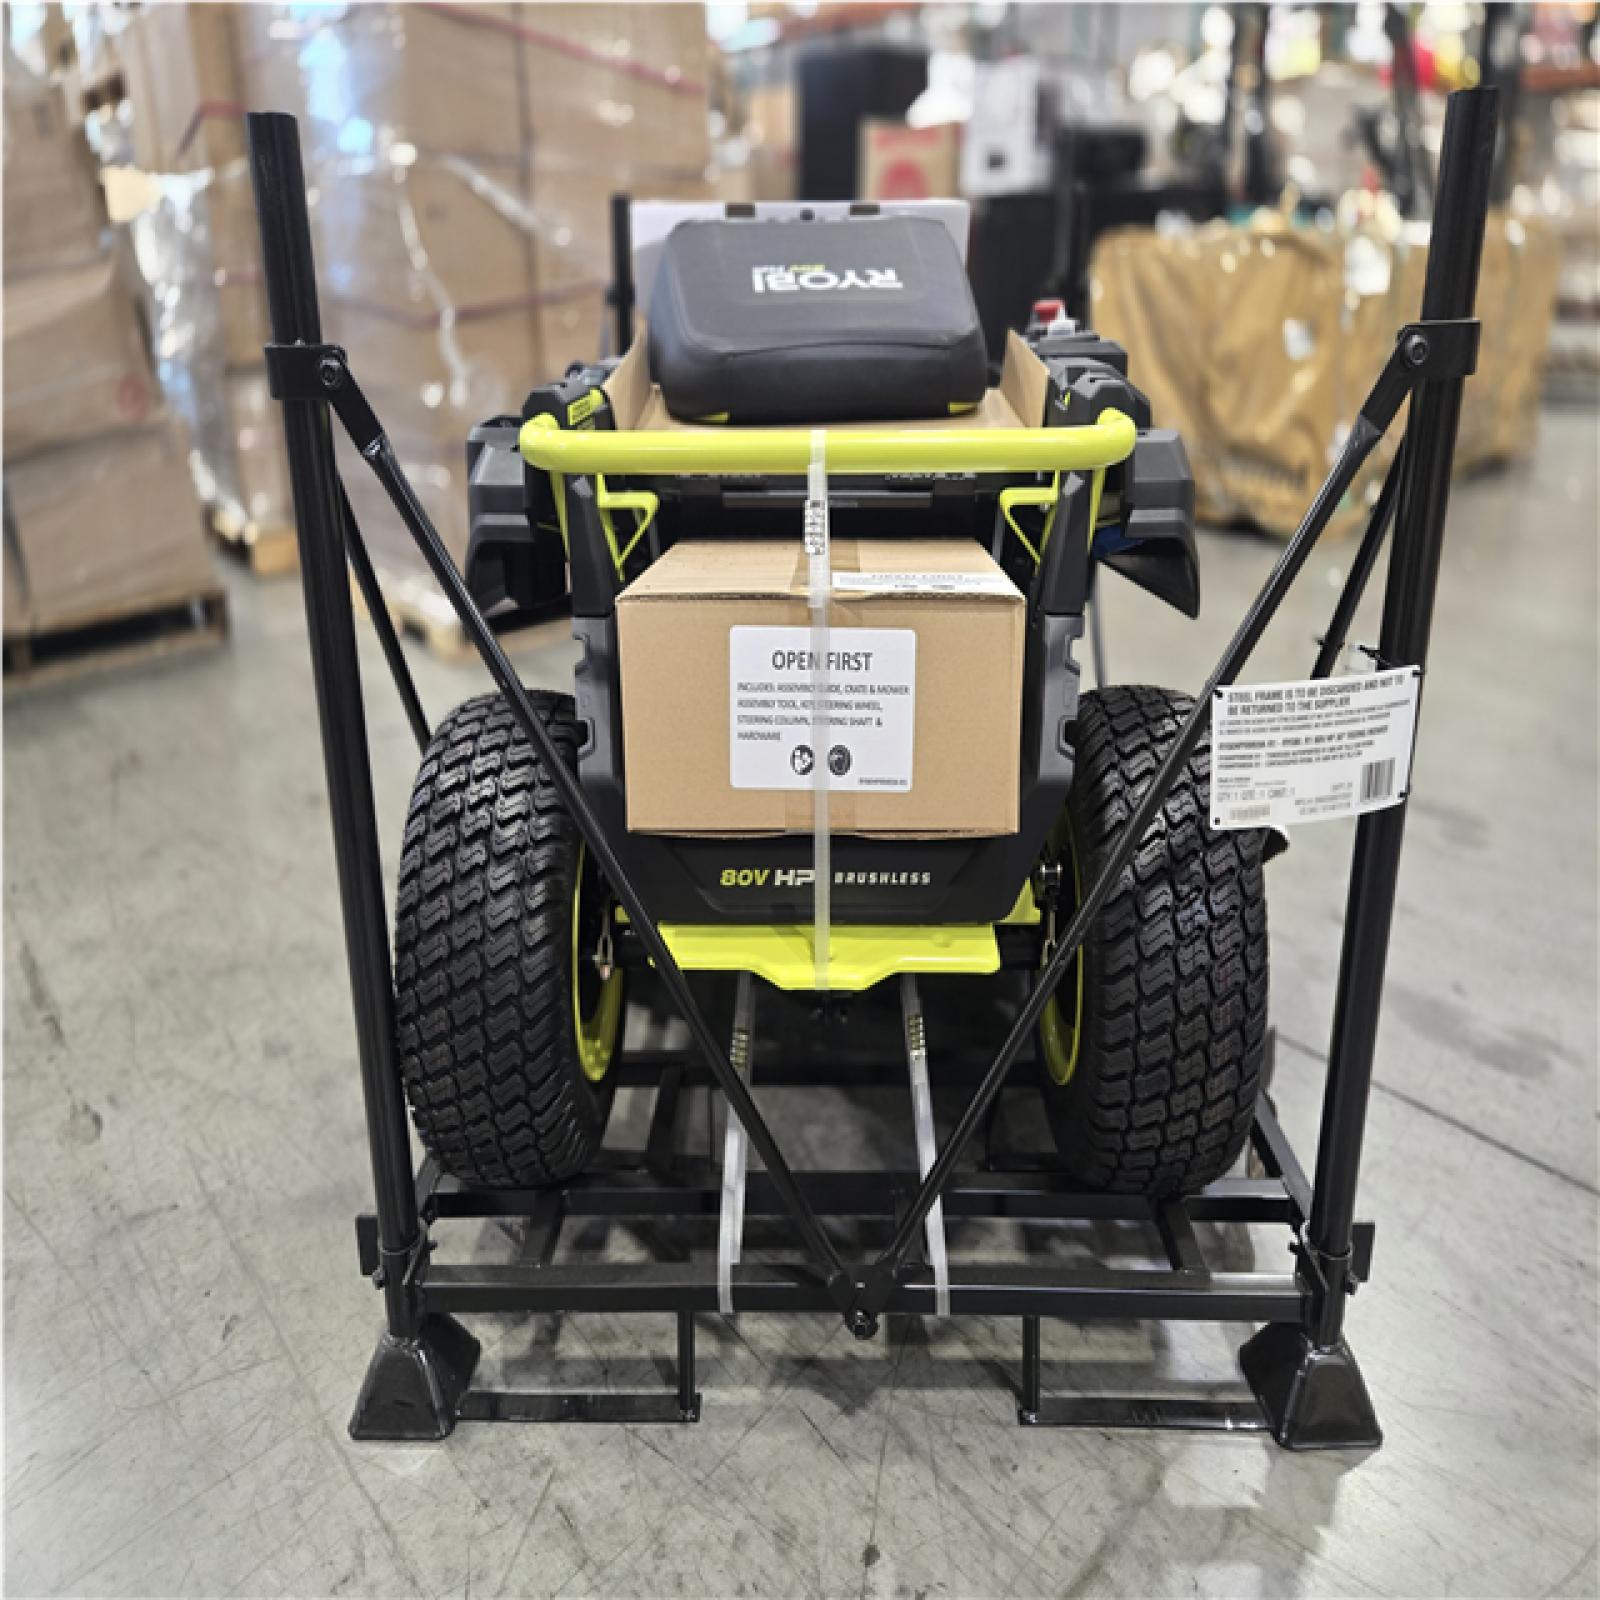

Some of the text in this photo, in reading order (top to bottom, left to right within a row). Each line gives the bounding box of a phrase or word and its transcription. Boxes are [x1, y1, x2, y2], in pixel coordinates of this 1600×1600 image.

[752, 267, 903, 293] RYOBI
[772, 649, 873, 671] OPEN FIRST
[875, 717, 883, 727] &
[720, 869, 931, 886] 80V HP BRUSHLESS
